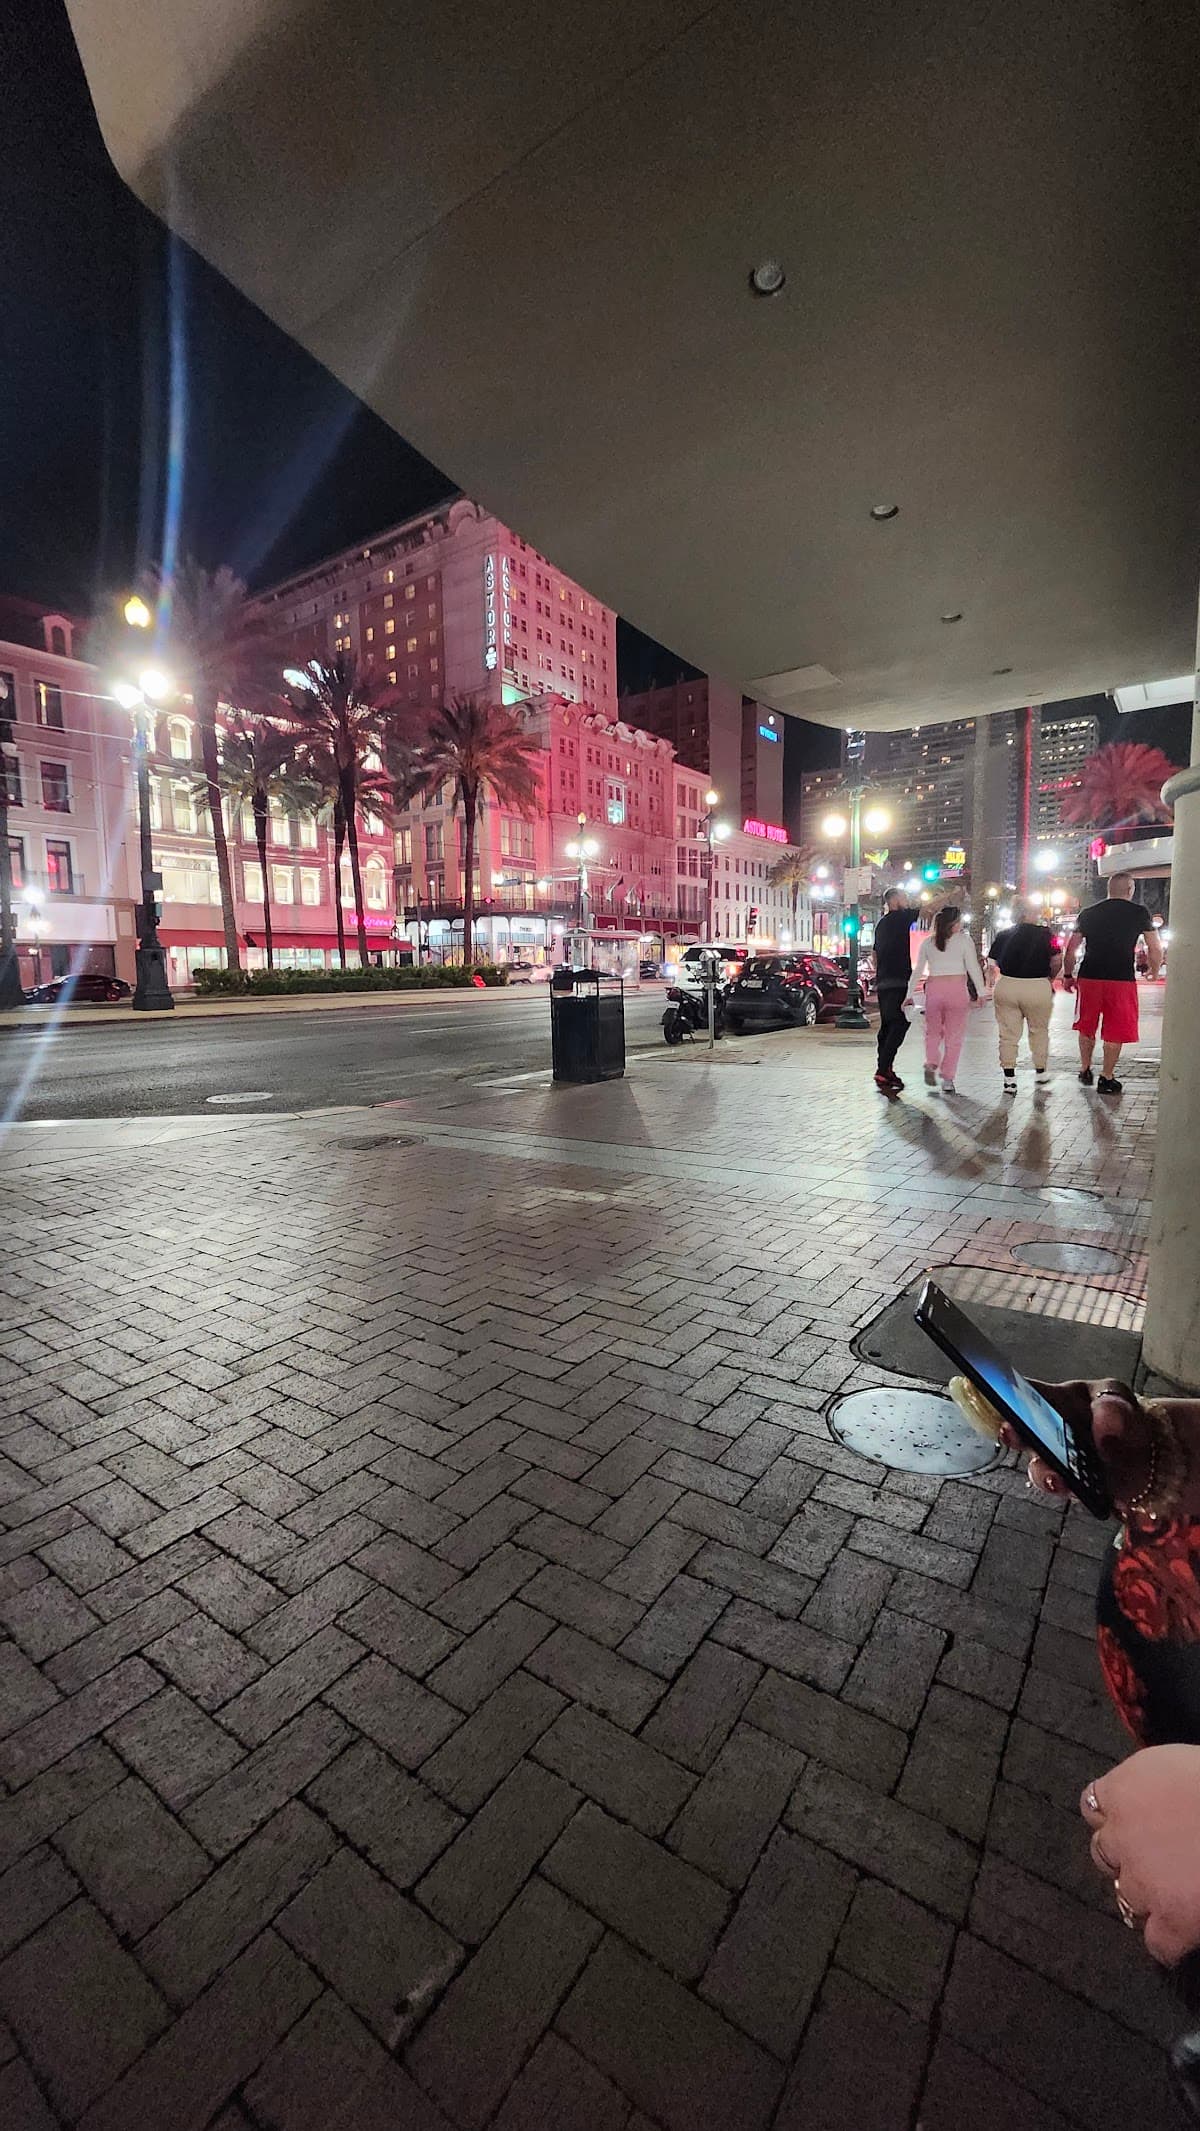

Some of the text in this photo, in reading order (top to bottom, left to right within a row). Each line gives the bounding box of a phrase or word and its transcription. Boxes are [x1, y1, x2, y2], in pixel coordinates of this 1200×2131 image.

[486, 554, 496, 645] ASTOR
[503, 557, 511, 645] ASTOR
[744, 819, 788, 843] ASTOR HOTEL
